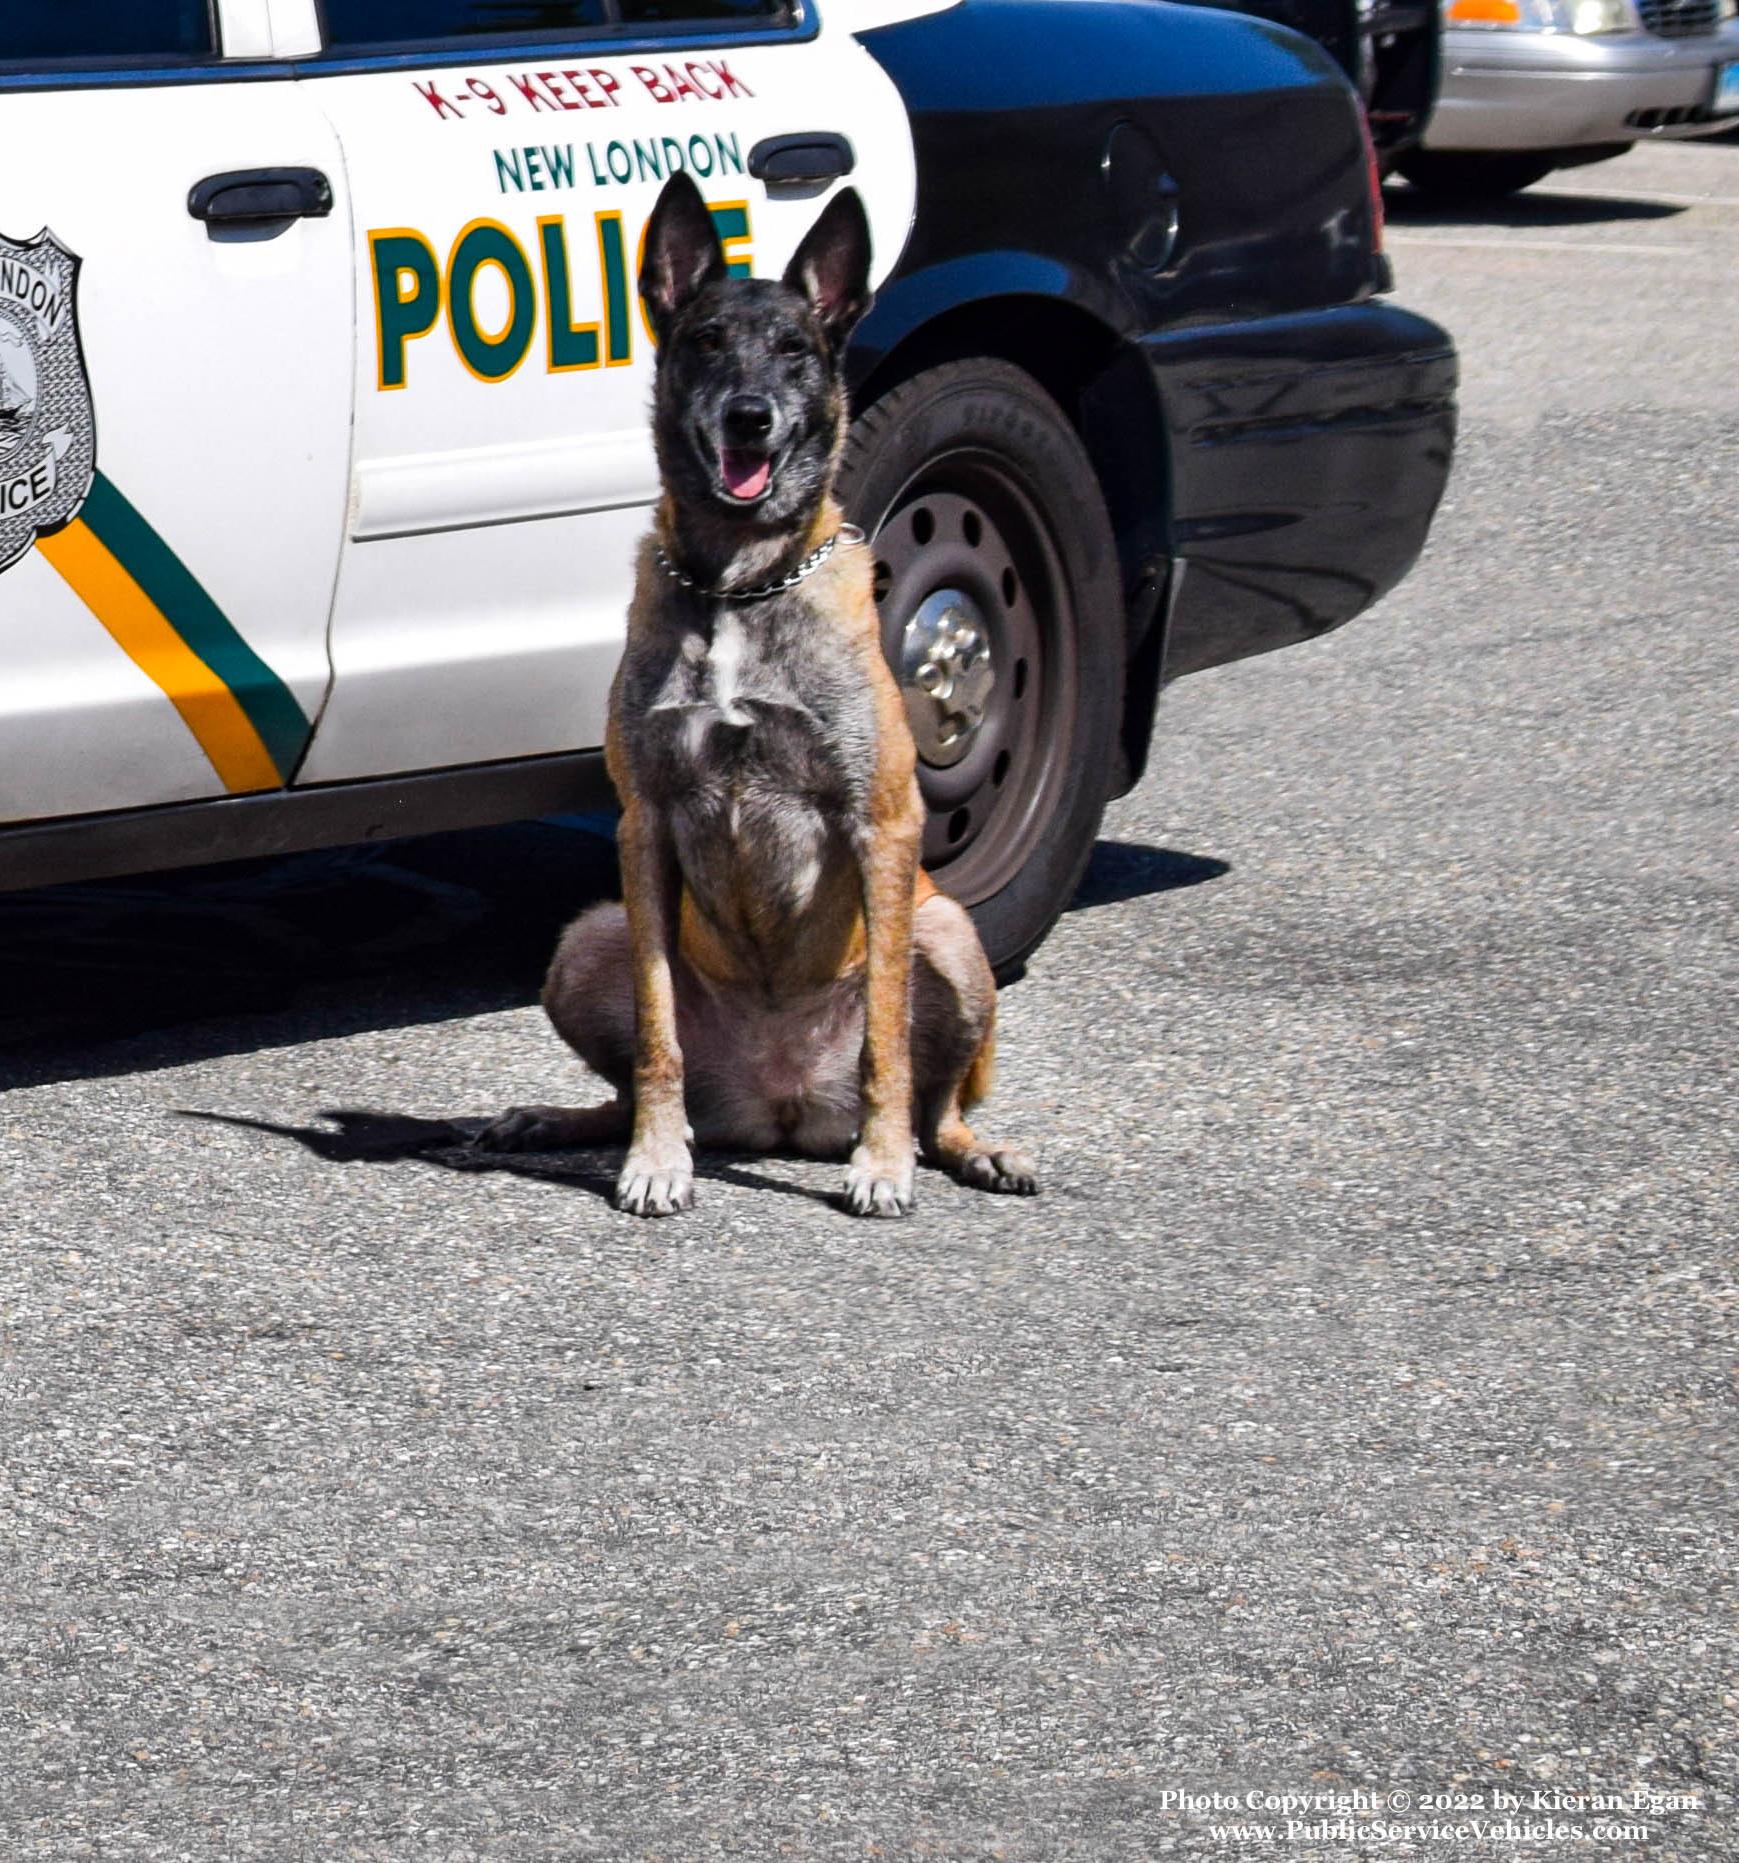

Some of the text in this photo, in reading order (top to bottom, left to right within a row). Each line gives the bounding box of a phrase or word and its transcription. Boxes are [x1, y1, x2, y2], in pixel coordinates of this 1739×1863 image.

[412, 60, 755, 120] K-9 KEEP BACK
[492, 132, 745, 194] NEW LONDON
[367, 199, 754, 392] POLI
